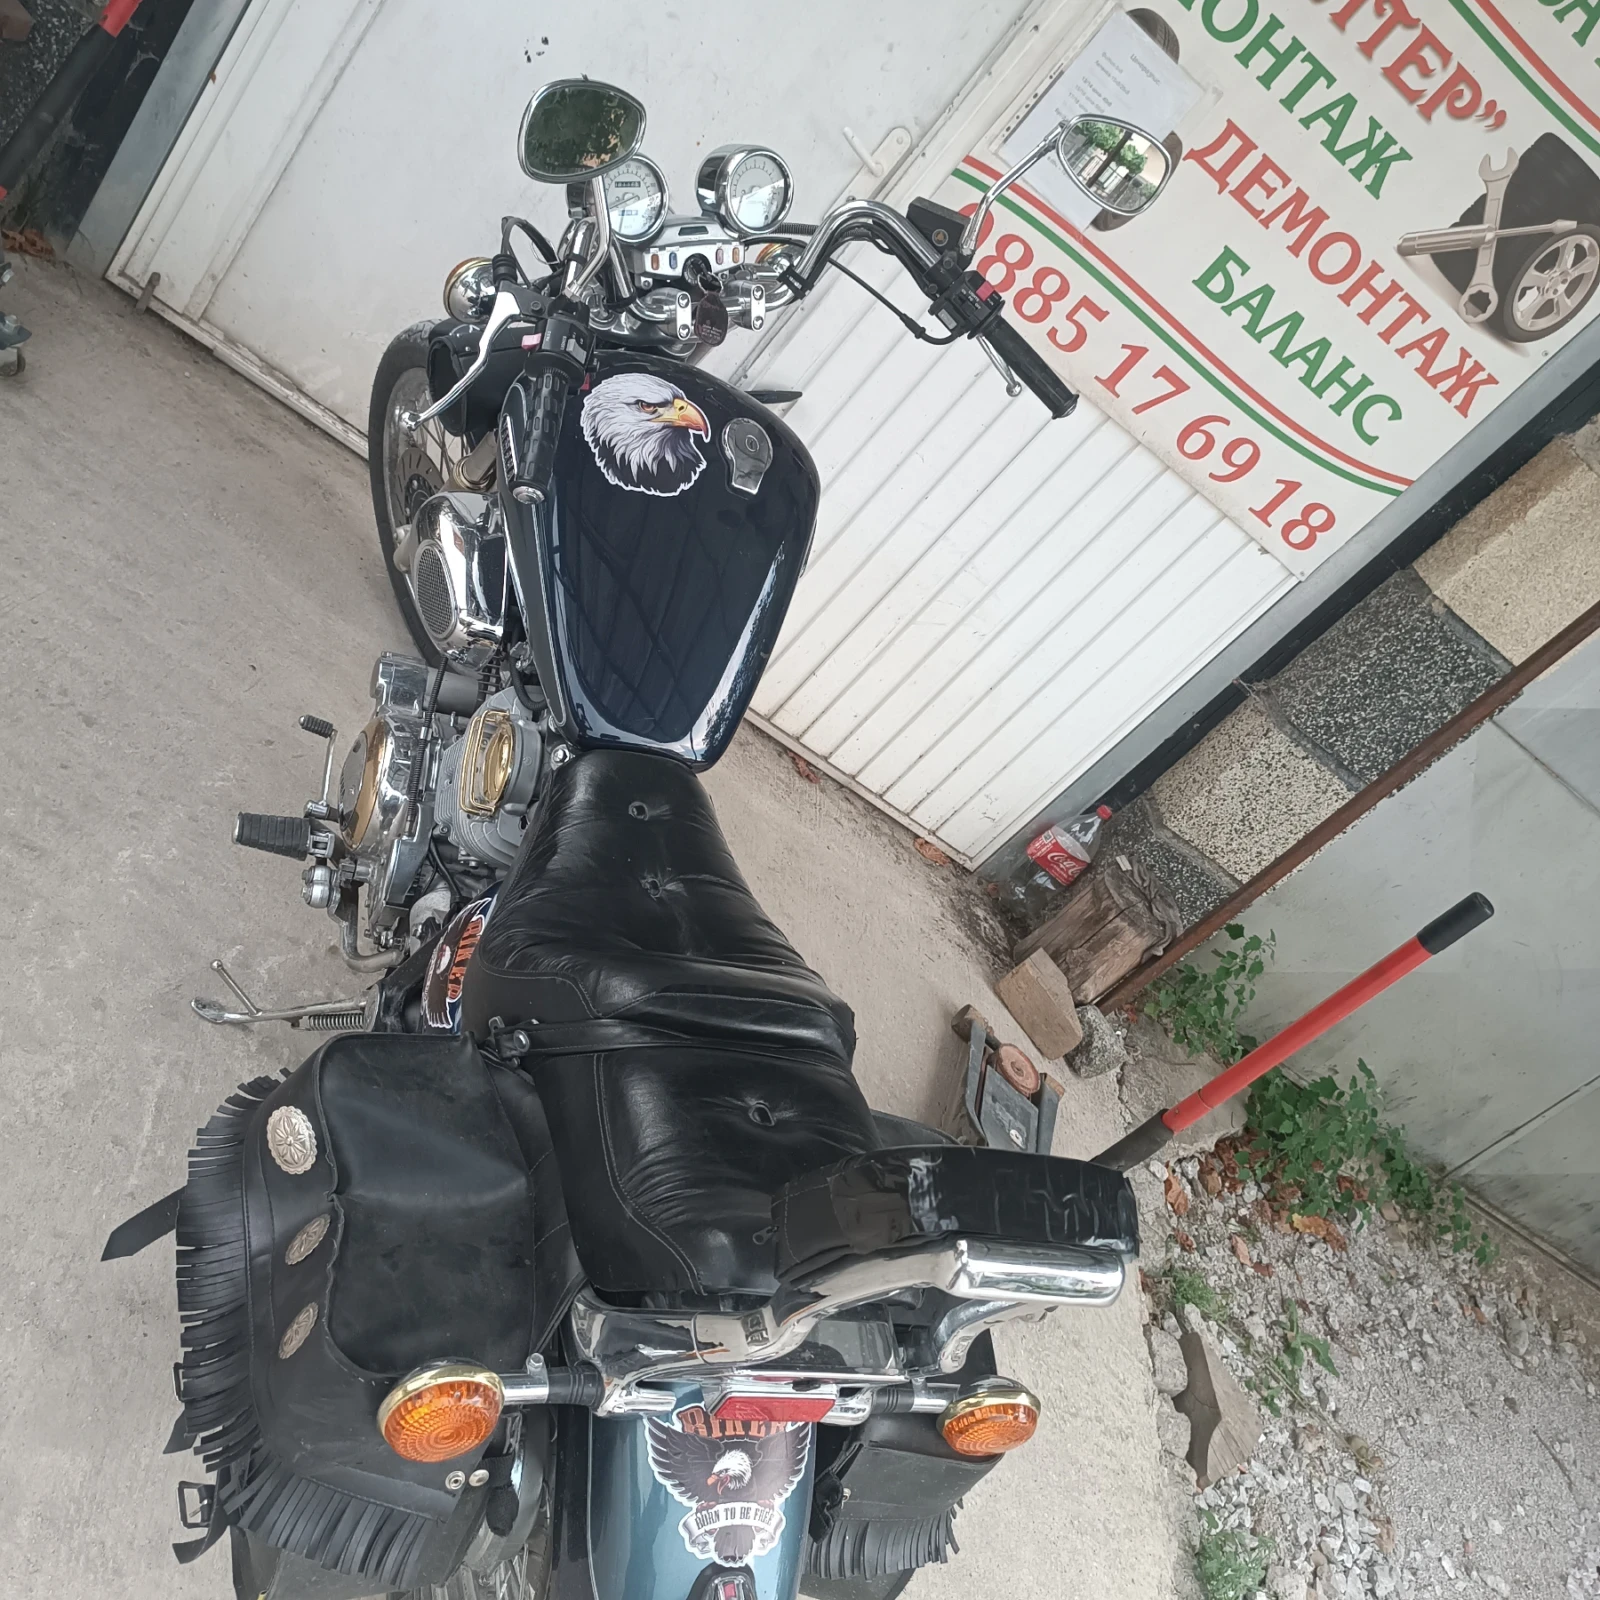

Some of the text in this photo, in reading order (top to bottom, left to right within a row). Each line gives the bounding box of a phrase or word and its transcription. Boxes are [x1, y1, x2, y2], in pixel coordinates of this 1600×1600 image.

[1177, 0, 1413, 200] ОНТАЖ
[1181, 119, 1500, 419] ДЕМОНТАЖ
[1191, 245, 1403, 447] БАЛАНС
[1094, 343, 1191, 416] 17
[1176, 414, 1261, 484] 69
[1248, 478, 1337, 552] 18
[695, 1506, 775, 1530] BORN TO BE FREE
